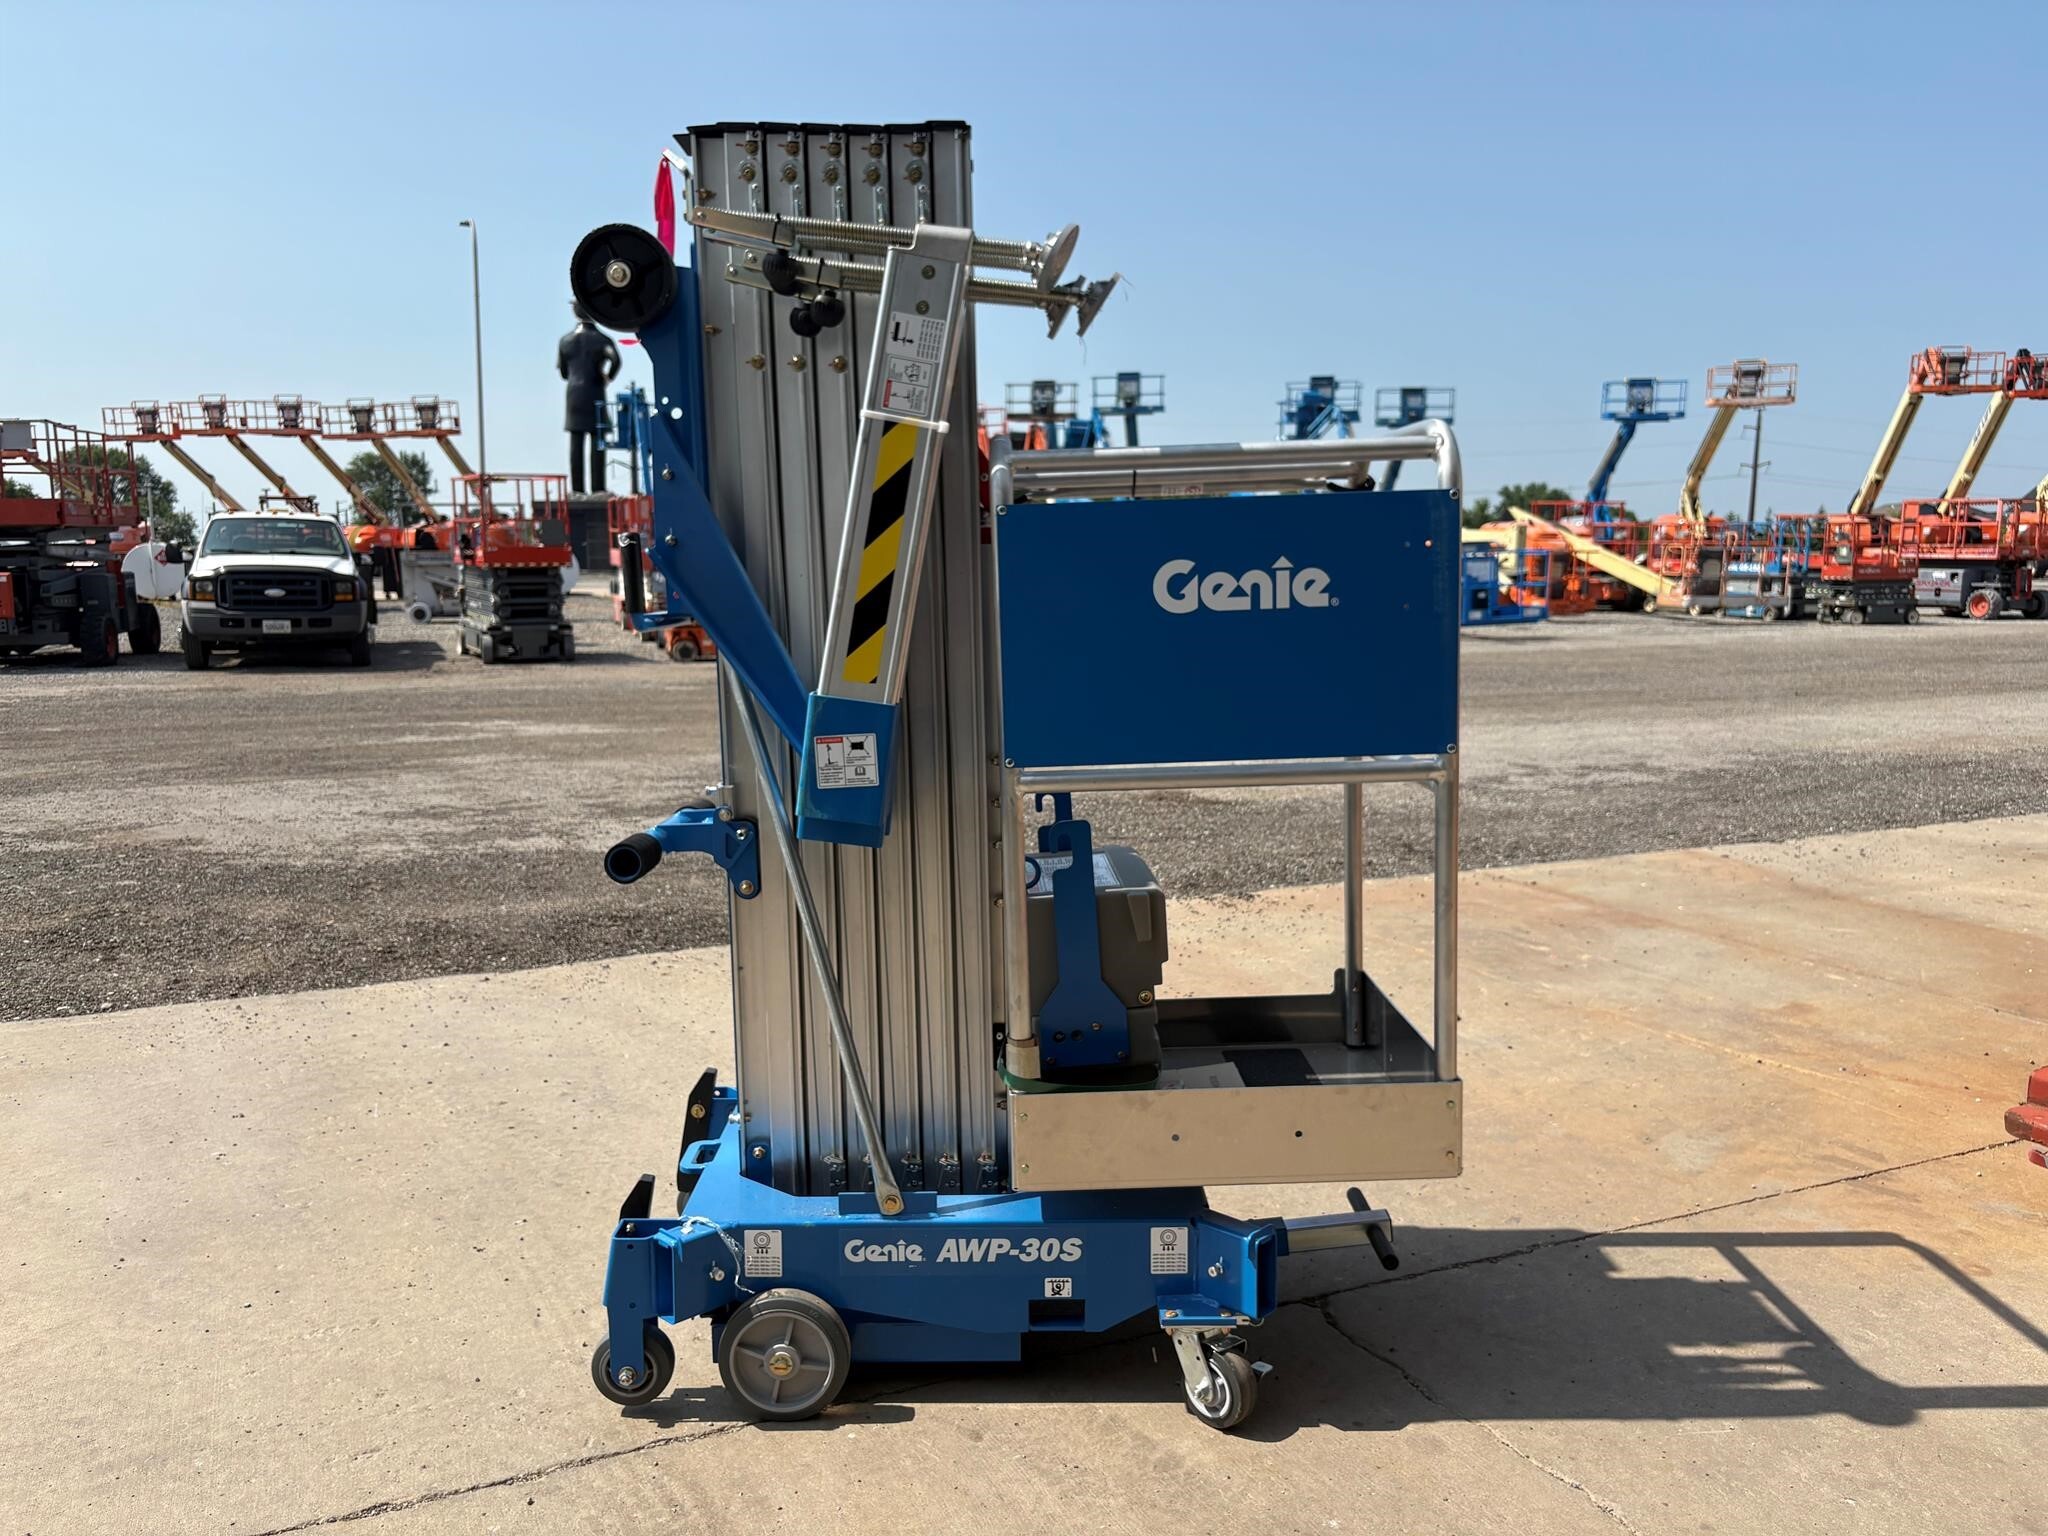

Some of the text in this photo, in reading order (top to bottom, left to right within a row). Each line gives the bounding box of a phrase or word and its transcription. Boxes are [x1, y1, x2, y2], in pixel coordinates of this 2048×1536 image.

[1153, 555, 1331, 614] Genie
[844, 1237, 1083, 1263] Genie AWP-30S
